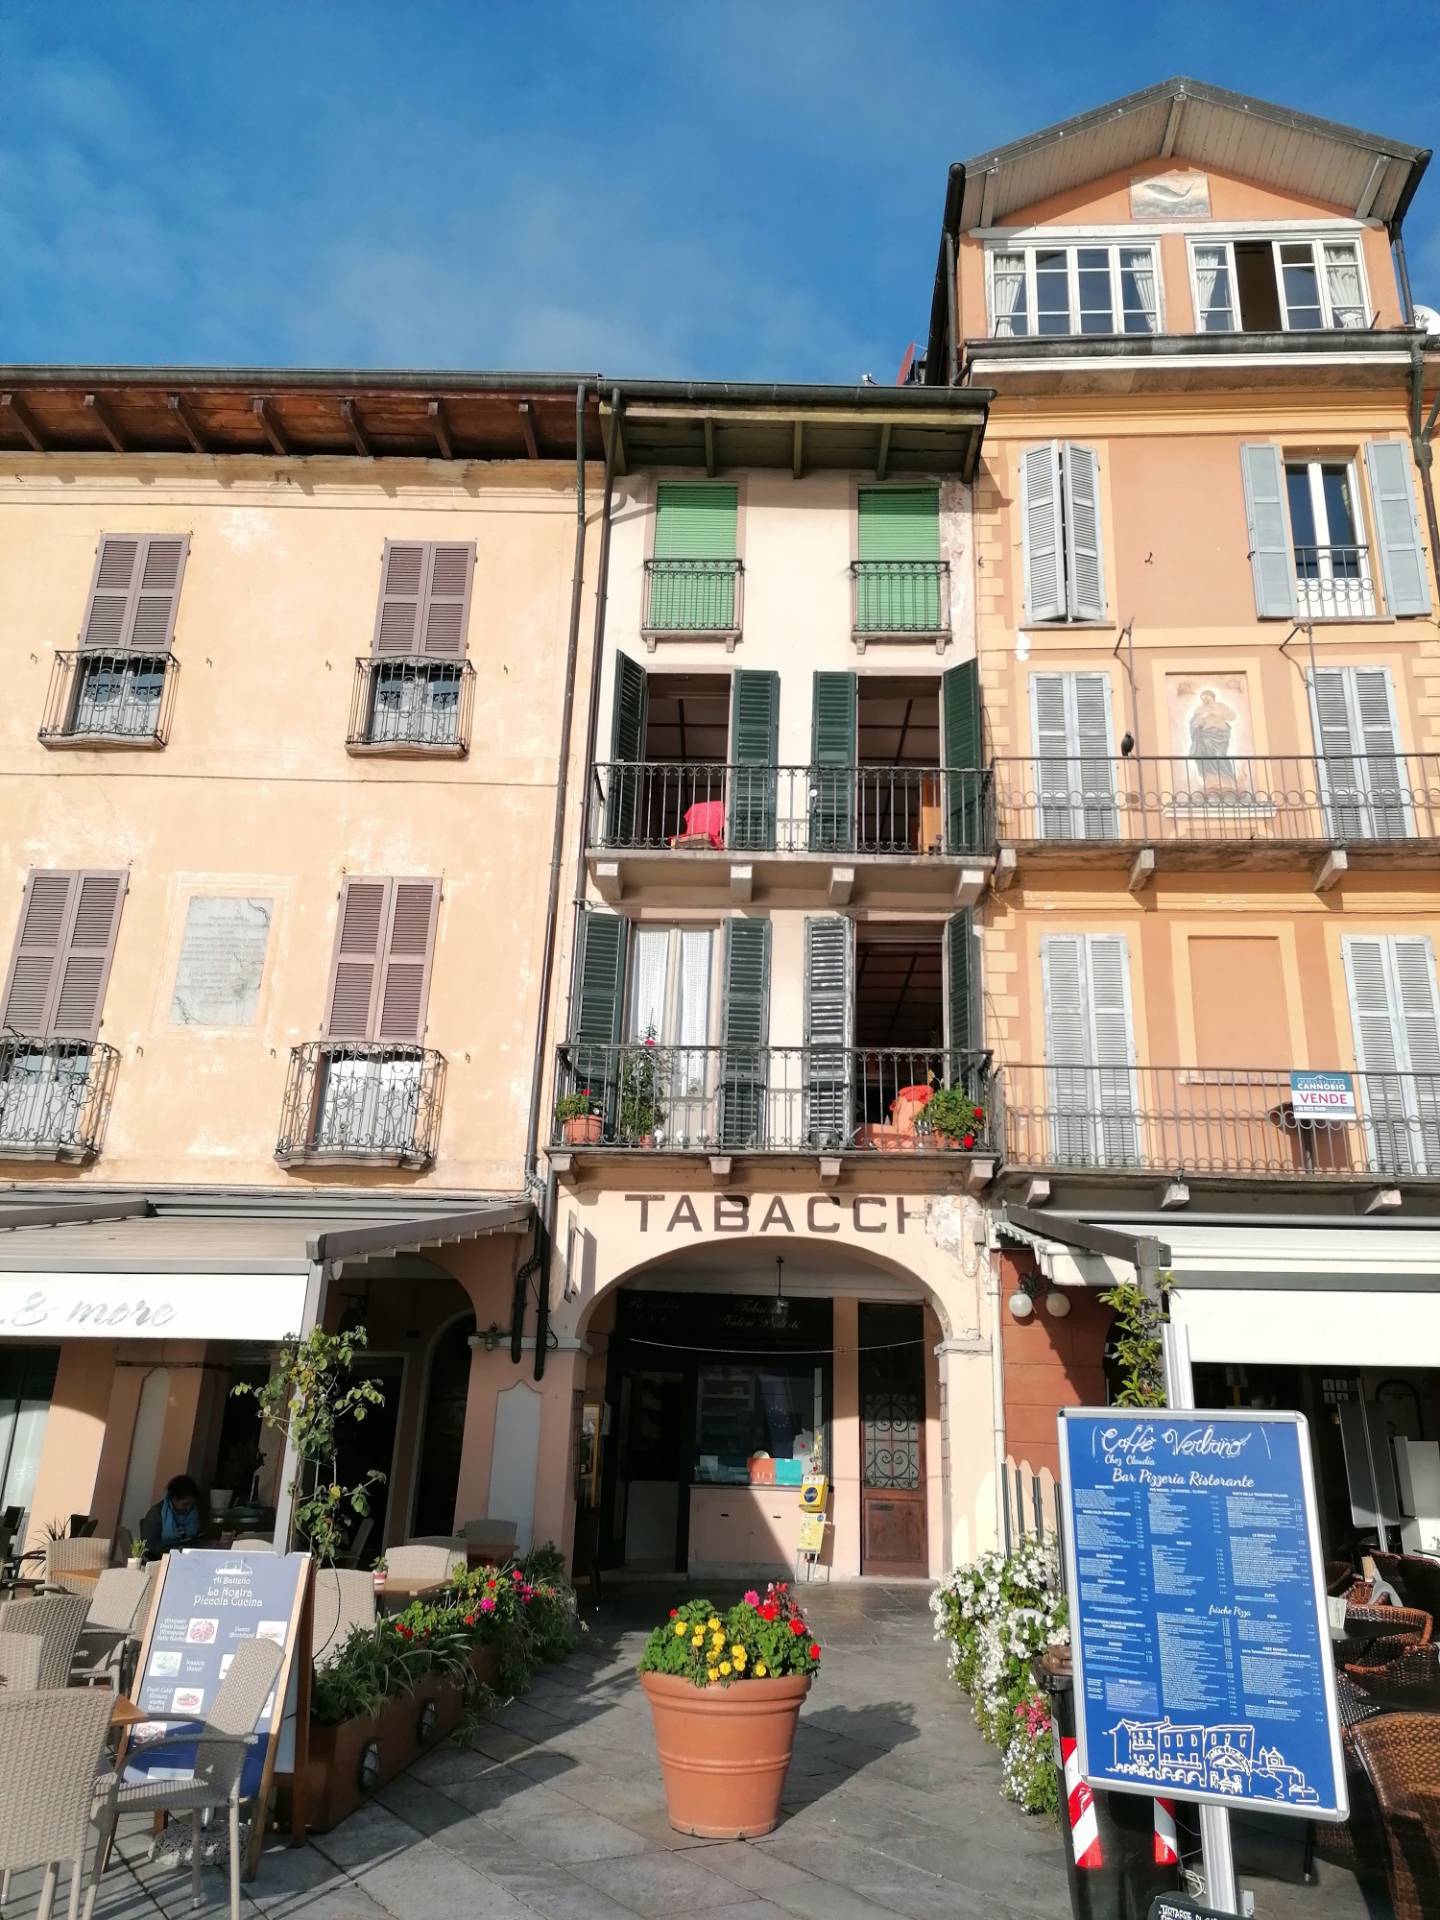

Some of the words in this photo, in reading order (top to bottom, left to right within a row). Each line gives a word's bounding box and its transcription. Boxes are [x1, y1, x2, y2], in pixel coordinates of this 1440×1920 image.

[1300, 1093, 1348, 1104] VENDE
[12, 1290, 58, 1327] &
[66, 1299, 178, 1327] more
[1100, 1424, 1157, 1453] Caffè
[1162, 1424, 1252, 1458] Verbano
[1104, 1454, 1122, 1466] Chez
[1126, 1455, 1156, 1466] Claudia
[1112, 1468, 1136, 1483] Bar
[1139, 1469, 1185, 1487] Pizzeria
[1189, 1471, 1256, 1488] Ristorante
[207, 1586, 219, 1596] La
[193, 1595, 228, 1606] Piccola
[231, 1598, 263, 1607] Cucina
[1208, 1603, 1232, 1616] frische
[1233, 1605, 1252, 1618] Pizza
